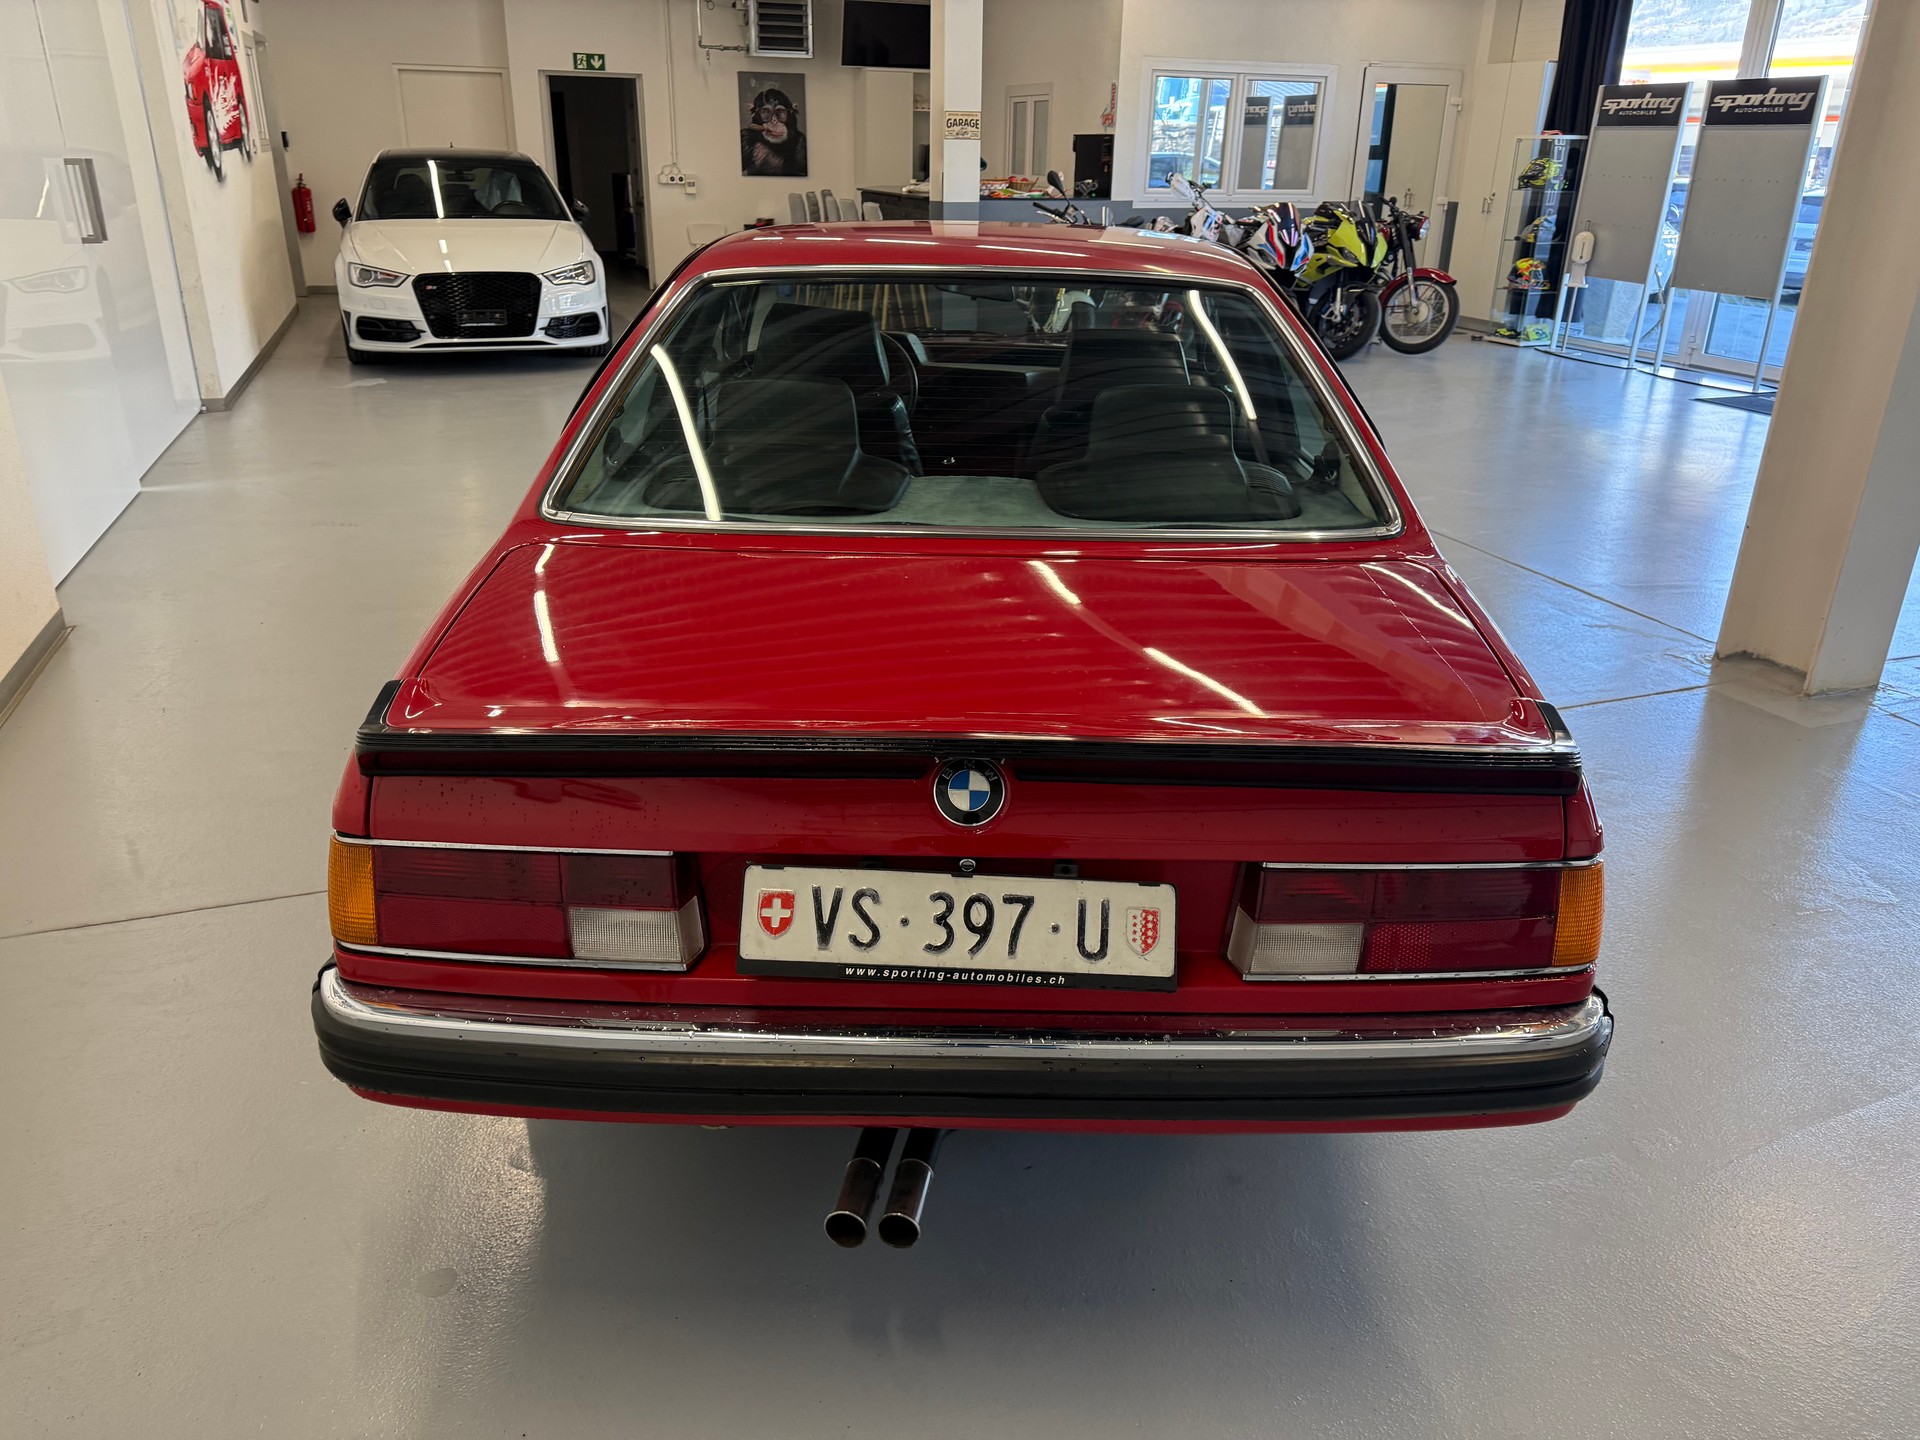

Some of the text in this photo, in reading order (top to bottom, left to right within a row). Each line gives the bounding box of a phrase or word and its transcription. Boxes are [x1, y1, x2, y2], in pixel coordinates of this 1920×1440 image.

[1601, 92, 1682, 114] sporting
[1710, 87, 1816, 112] sporting
[946, 118, 980, 130] GARAGE
[942, 759, 998, 782] BMW
[844, 967, 1066, 985] www.sporting-automobiles.ch
